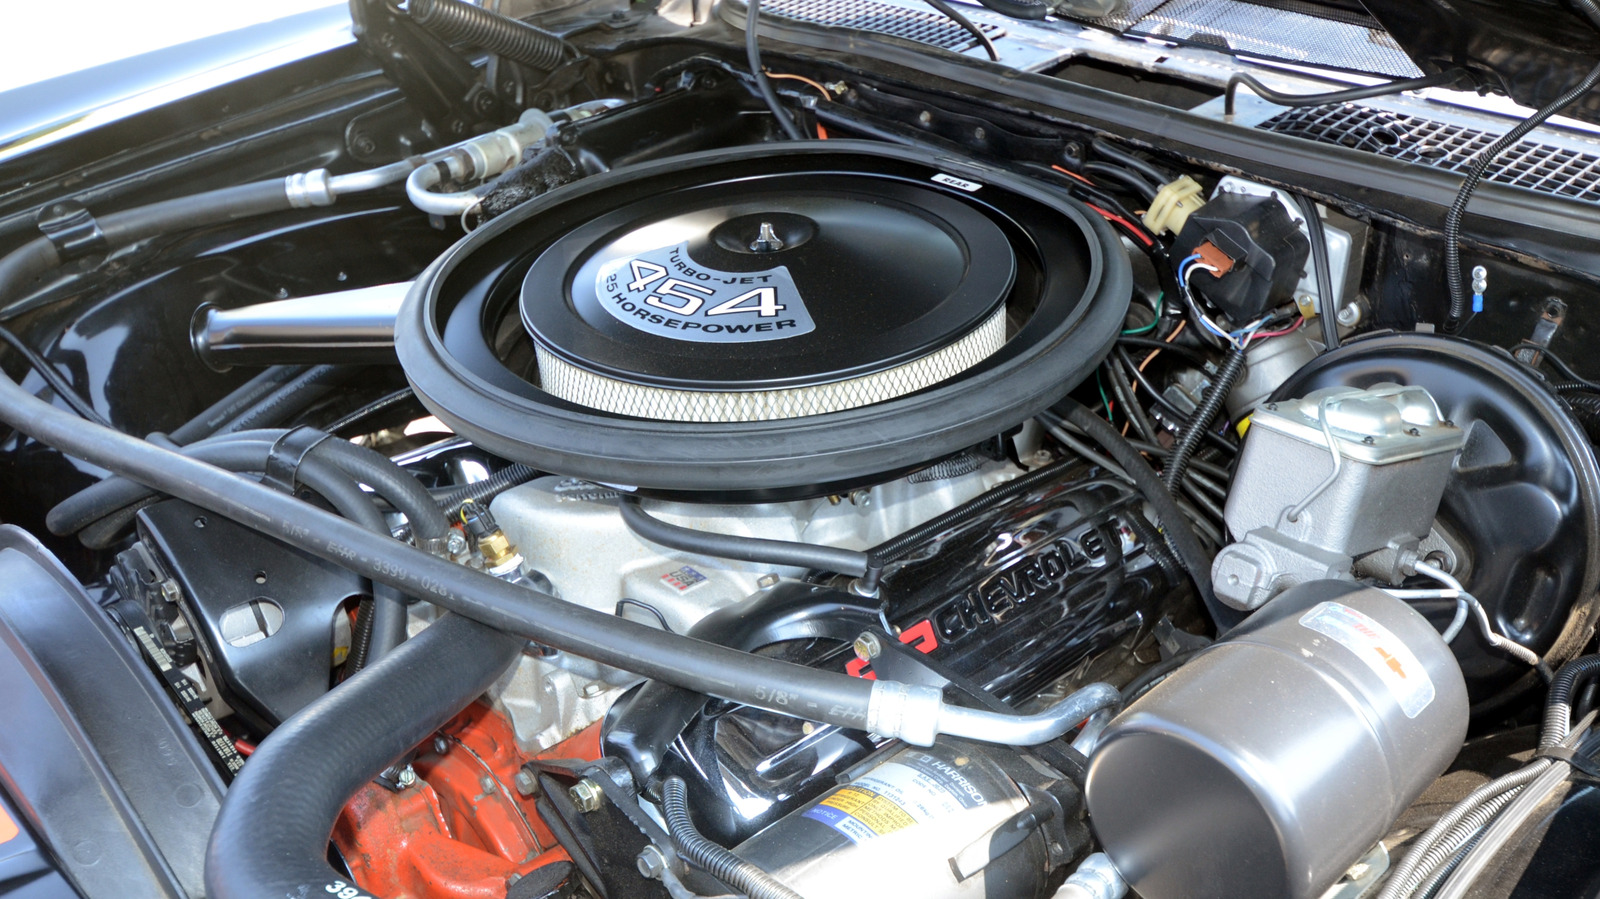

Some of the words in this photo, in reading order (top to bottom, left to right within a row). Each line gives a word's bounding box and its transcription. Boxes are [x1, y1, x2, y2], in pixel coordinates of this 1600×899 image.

[943, 178, 969, 188] REAR
[669, 247, 773, 284] TURBO-JET
[626, 259, 787, 317] 454
[612, 292, 797, 333] HORSEPOWER
[933, 518, 1122, 643] CHEVROLET
